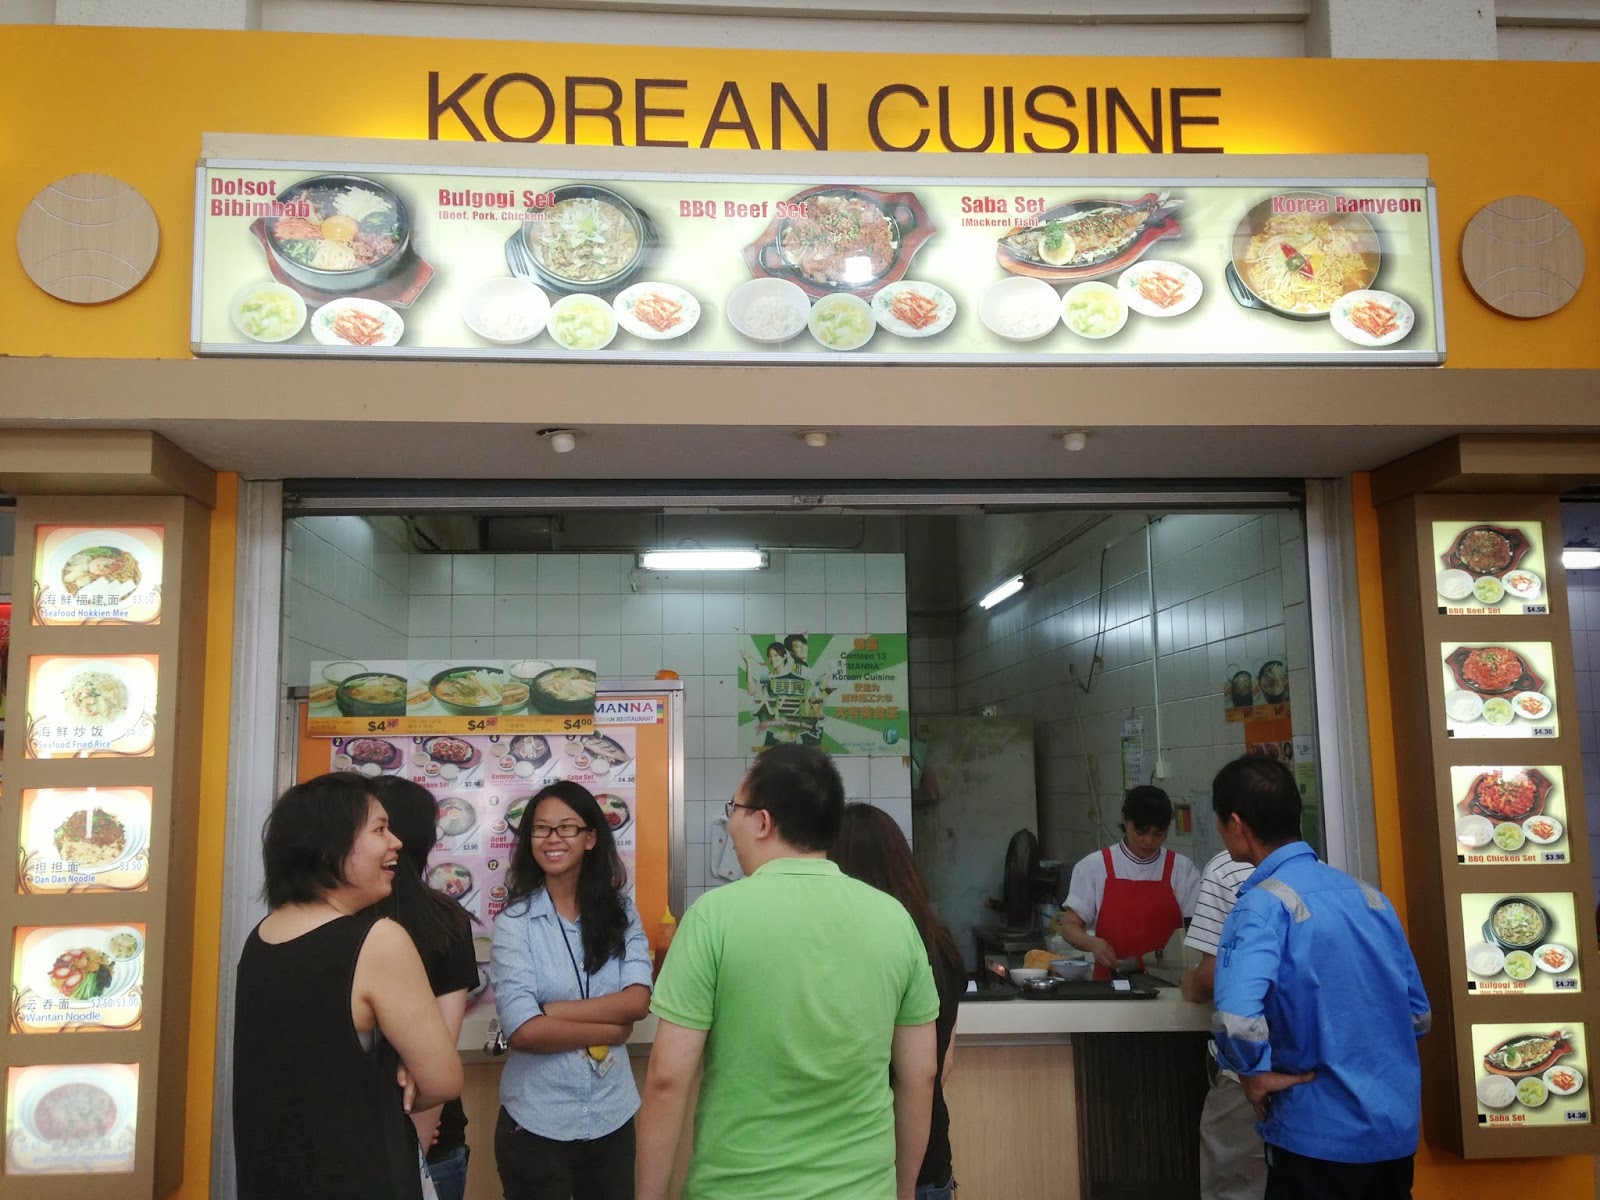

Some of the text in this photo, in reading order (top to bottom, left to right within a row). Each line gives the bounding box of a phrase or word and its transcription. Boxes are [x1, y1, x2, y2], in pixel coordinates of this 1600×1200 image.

[428, 71, 1224, 154] KOREAN CUISINE
[211, 178, 276, 196] Dolsot
[438, 189, 556, 208] Bulgogi Set
[961, 196, 1046, 213] Saba Set
[1272, 196, 1422, 214] Korea Ramyeon
[211, 199, 310, 217] Bibimbab
[679, 200, 808, 219] BBQ Beef Set
[44, 609, 76, 617] Seafood
[78, 609, 110, 617] Hokkien
[832, 673, 895, 681] Korean Cuisine
[594, 702, 653, 714] MANNA
[38, 741, 70, 749] Seafood
[26, 1011, 101, 1021] Wantan Noodle
